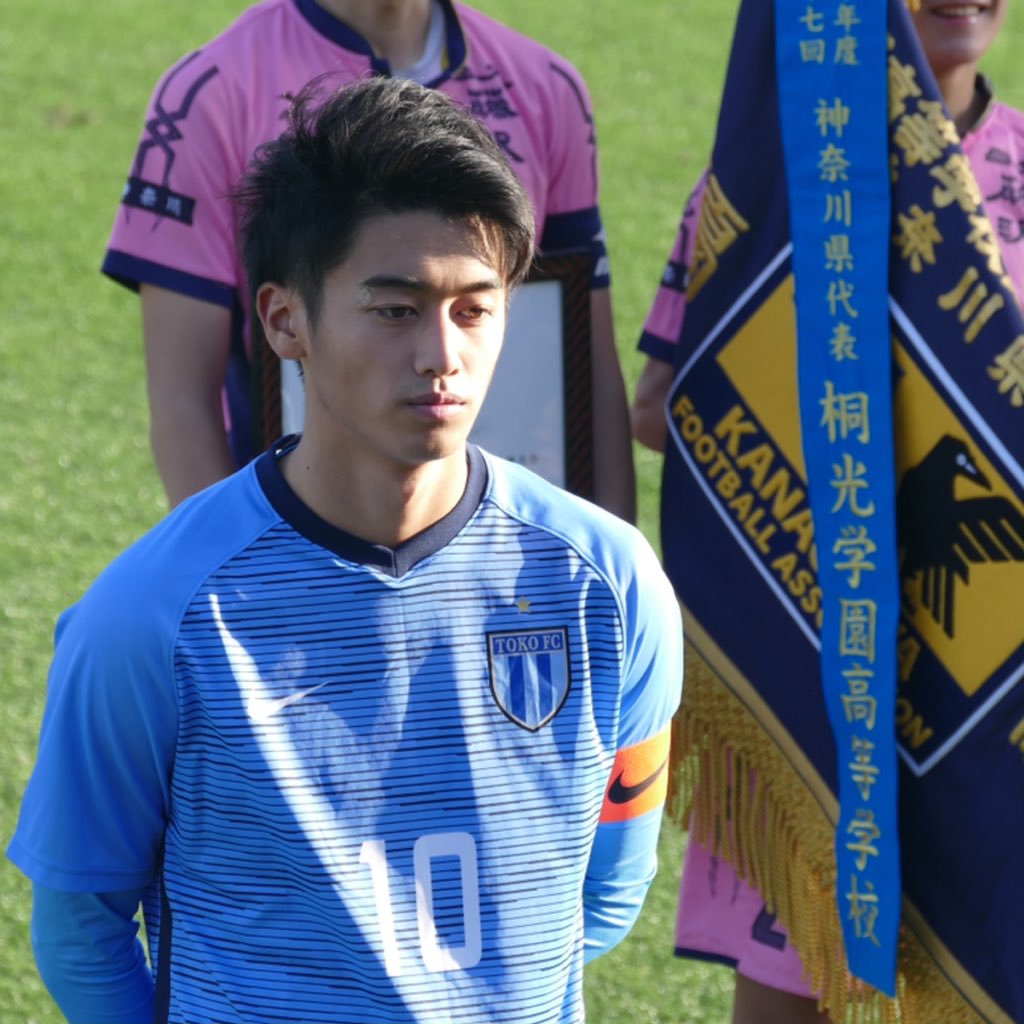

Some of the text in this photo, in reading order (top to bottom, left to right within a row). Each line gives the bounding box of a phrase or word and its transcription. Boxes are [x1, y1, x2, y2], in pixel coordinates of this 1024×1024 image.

[672, 395, 777, 555] FOOTBALL
[495, 634, 561, 653] TOKO FC
[359, 831, 482, 976] 10
